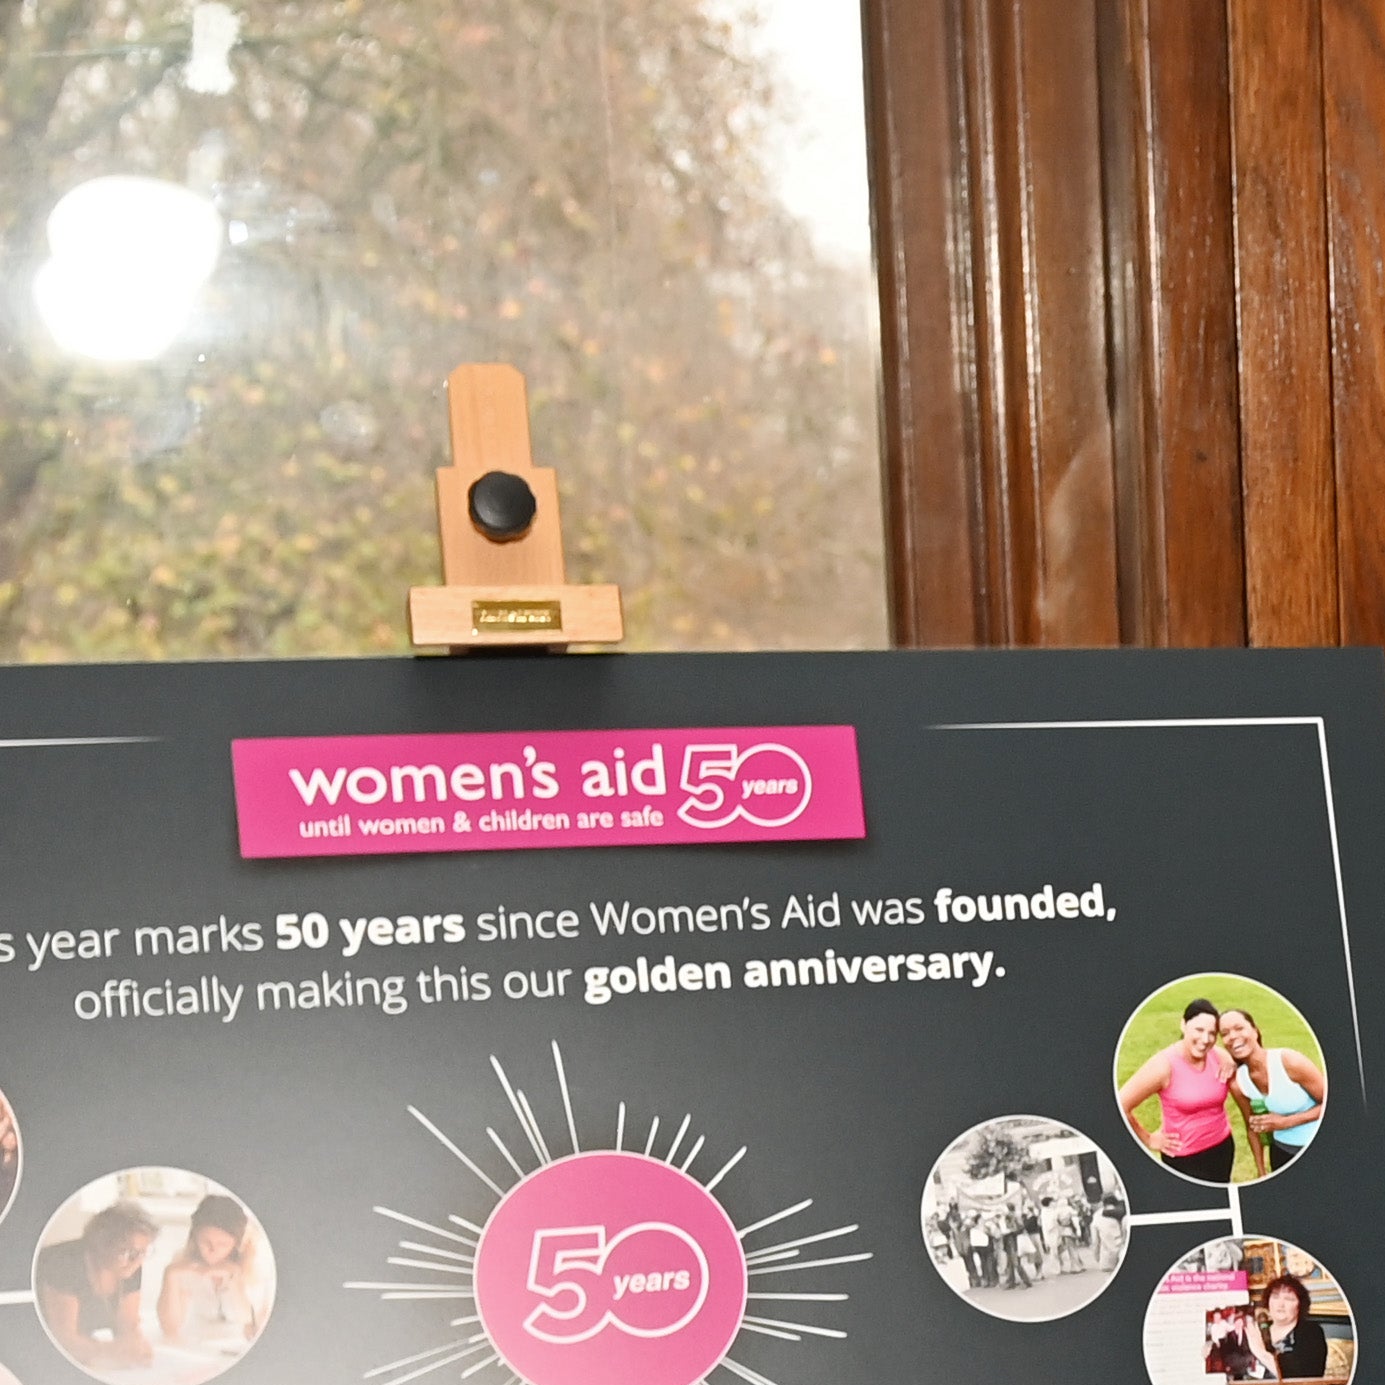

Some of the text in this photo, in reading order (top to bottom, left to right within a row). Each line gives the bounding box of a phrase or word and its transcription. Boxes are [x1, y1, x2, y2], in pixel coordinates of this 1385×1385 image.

[289, 743, 666, 806] women's aid
[677, 743, 812, 829] 50 years
[300, 805, 664, 838] until women & children are safe
[26, 929, 120, 971] year
[135, 915, 263, 955] marks
[276, 913, 329, 949] 50
[339, 914, 465, 956] years
[477, 906, 579, 941] since
[590, 897, 770, 935] Women's
[782, 892, 840, 928] Aid
[852, 898, 924, 925] was
[934, 883, 1116, 922] founded,
[75, 949, 1005, 1022] officially making this our golden anniversary.
[522, 1221, 710, 1345] 50 years
